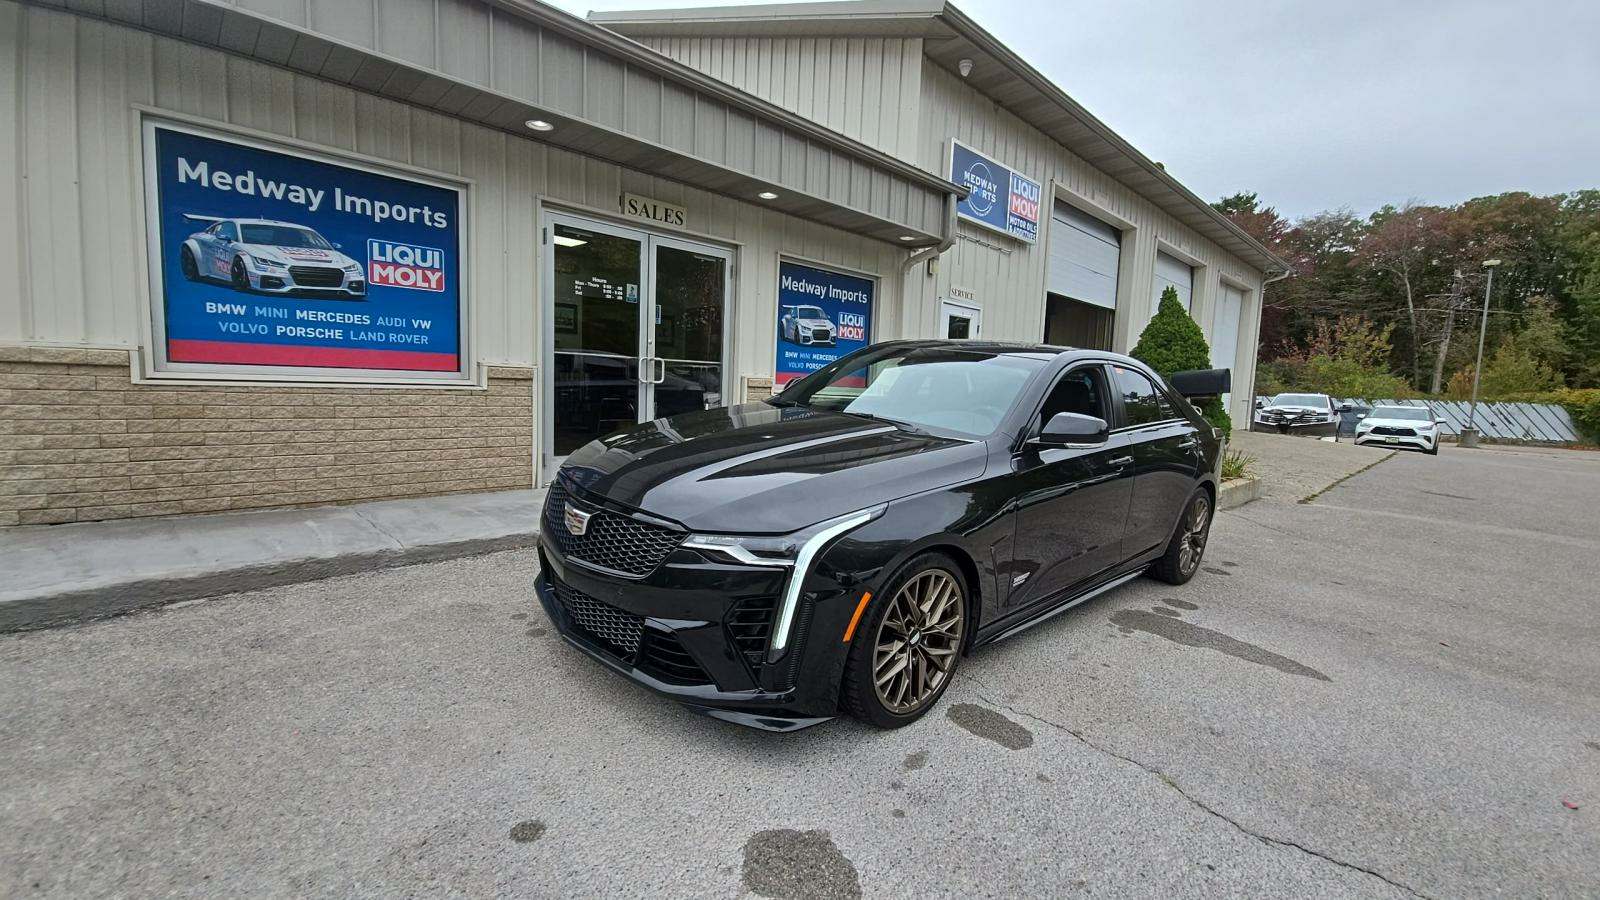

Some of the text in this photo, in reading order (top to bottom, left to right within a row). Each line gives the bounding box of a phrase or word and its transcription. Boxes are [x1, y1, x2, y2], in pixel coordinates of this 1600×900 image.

[177, 157, 448, 229] Medway Imports
[964, 170, 997, 193] MEDWAY
[1013, 177, 1038, 202] LIQUI
[628, 199, 684, 226] SALES
[1011, 195, 1037, 220] MOLY
[372, 242, 443, 268] LIQUI
[372, 264, 442, 290] MOLY
[592, 276, 607, 284] Hours
[782, 276, 867, 303] Medway Imports
[951, 288, 975, 300] SERVICE
[206, 302, 432, 330] BMW MINI MERCEDES AUDI VW
[839, 313, 864, 327] LIQUI
[218, 321, 429, 345] VOLVO PORSCHE LAND ROVER
[839, 325, 864, 339] MOLY
[800, 352, 811, 360] MINI
